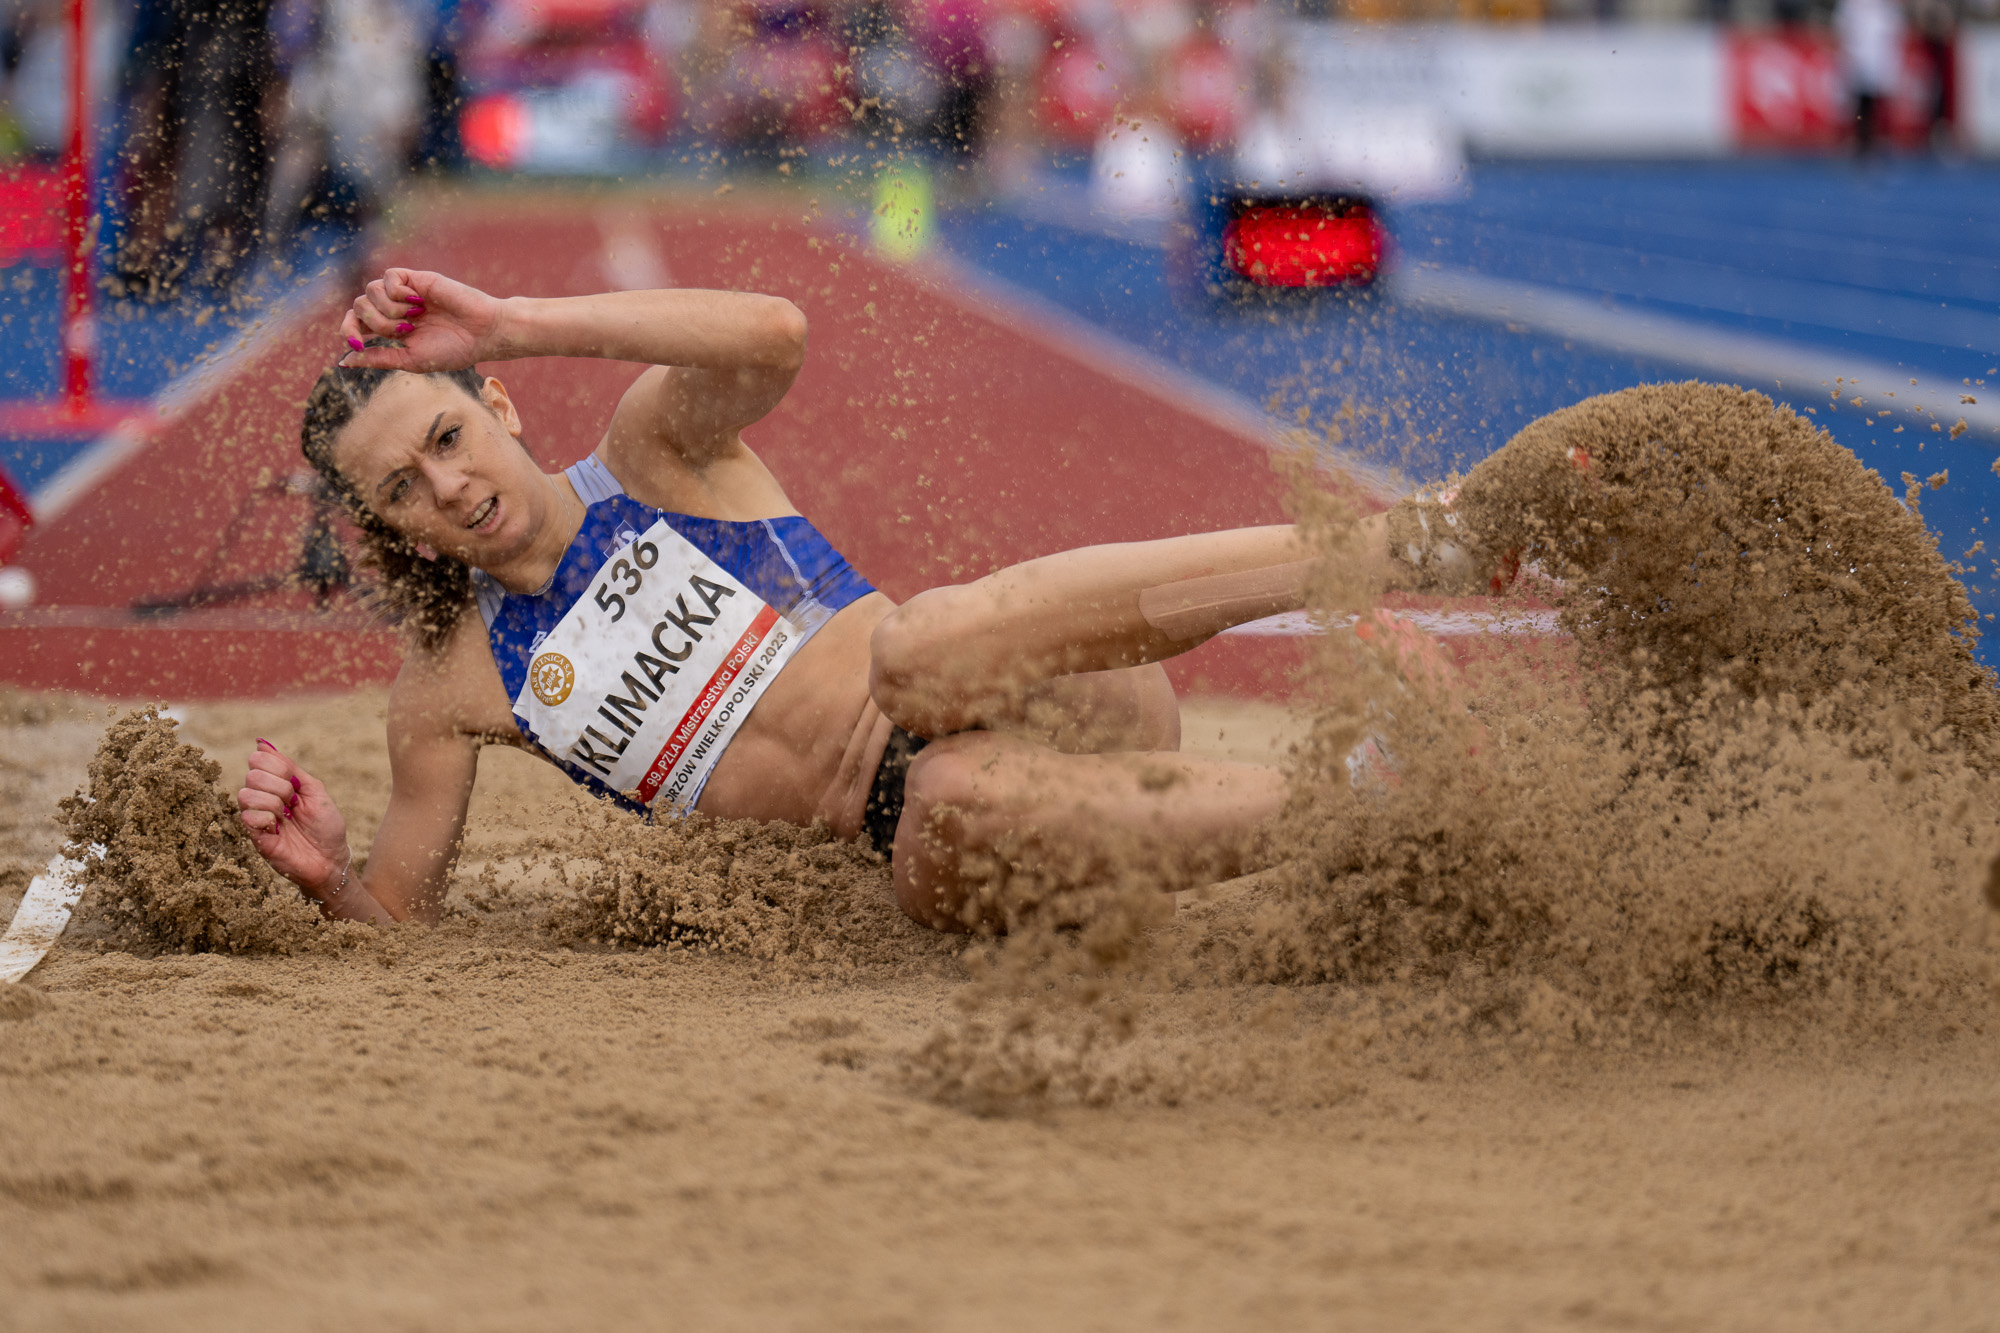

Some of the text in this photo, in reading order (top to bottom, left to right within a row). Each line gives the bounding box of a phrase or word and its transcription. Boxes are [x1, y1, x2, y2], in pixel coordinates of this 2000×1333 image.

[594, 541, 659, 624] 536
[532, 654, 565, 673] WITNICA
[570, 574, 737, 776] KLIMACKA
[646, 632, 760, 788] 99. PZLA Mistrzostwa Polski
[665, 631, 788, 803] ORZÓW WIELKOPOLSKI 2023
